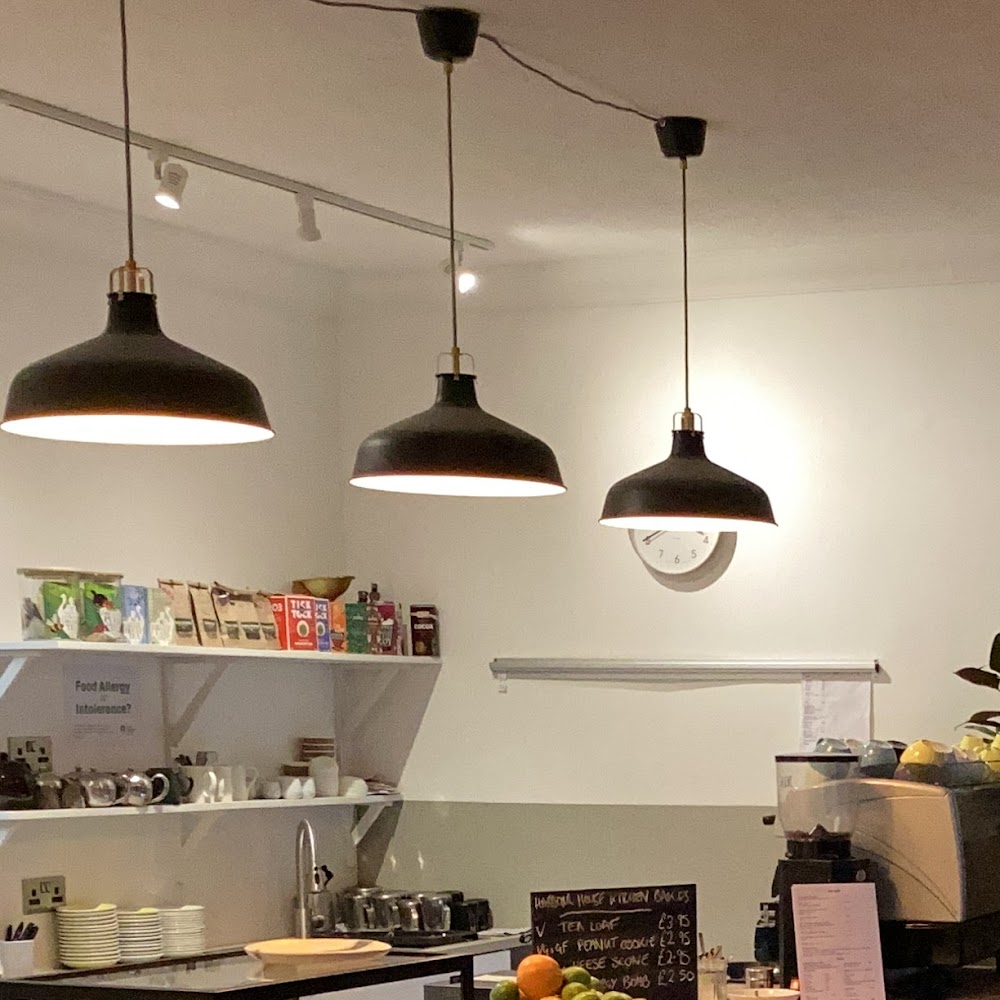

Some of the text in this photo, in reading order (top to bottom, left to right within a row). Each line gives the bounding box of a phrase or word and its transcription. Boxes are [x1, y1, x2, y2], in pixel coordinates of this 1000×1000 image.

[702, 535, 709, 544] 4
[659, 549, 664, 558] 7
[674, 554, 680, 564] 6
[691, 549, 697, 559] 5
[290, 599, 312, 609] TICK
[76, 680, 131, 695] Food Allergy
[75, 703, 132, 714] Intolerance?
[576, 891, 606, 908] HOUSE
[535, 921, 547, 938] V
[557, 920, 586, 934] TEA
[589, 917, 621, 932] LOAF
[576, 936, 619, 952] PEANUT
[610, 953, 650, 969] SCONE
[622, 974, 651, 989] BOMB
